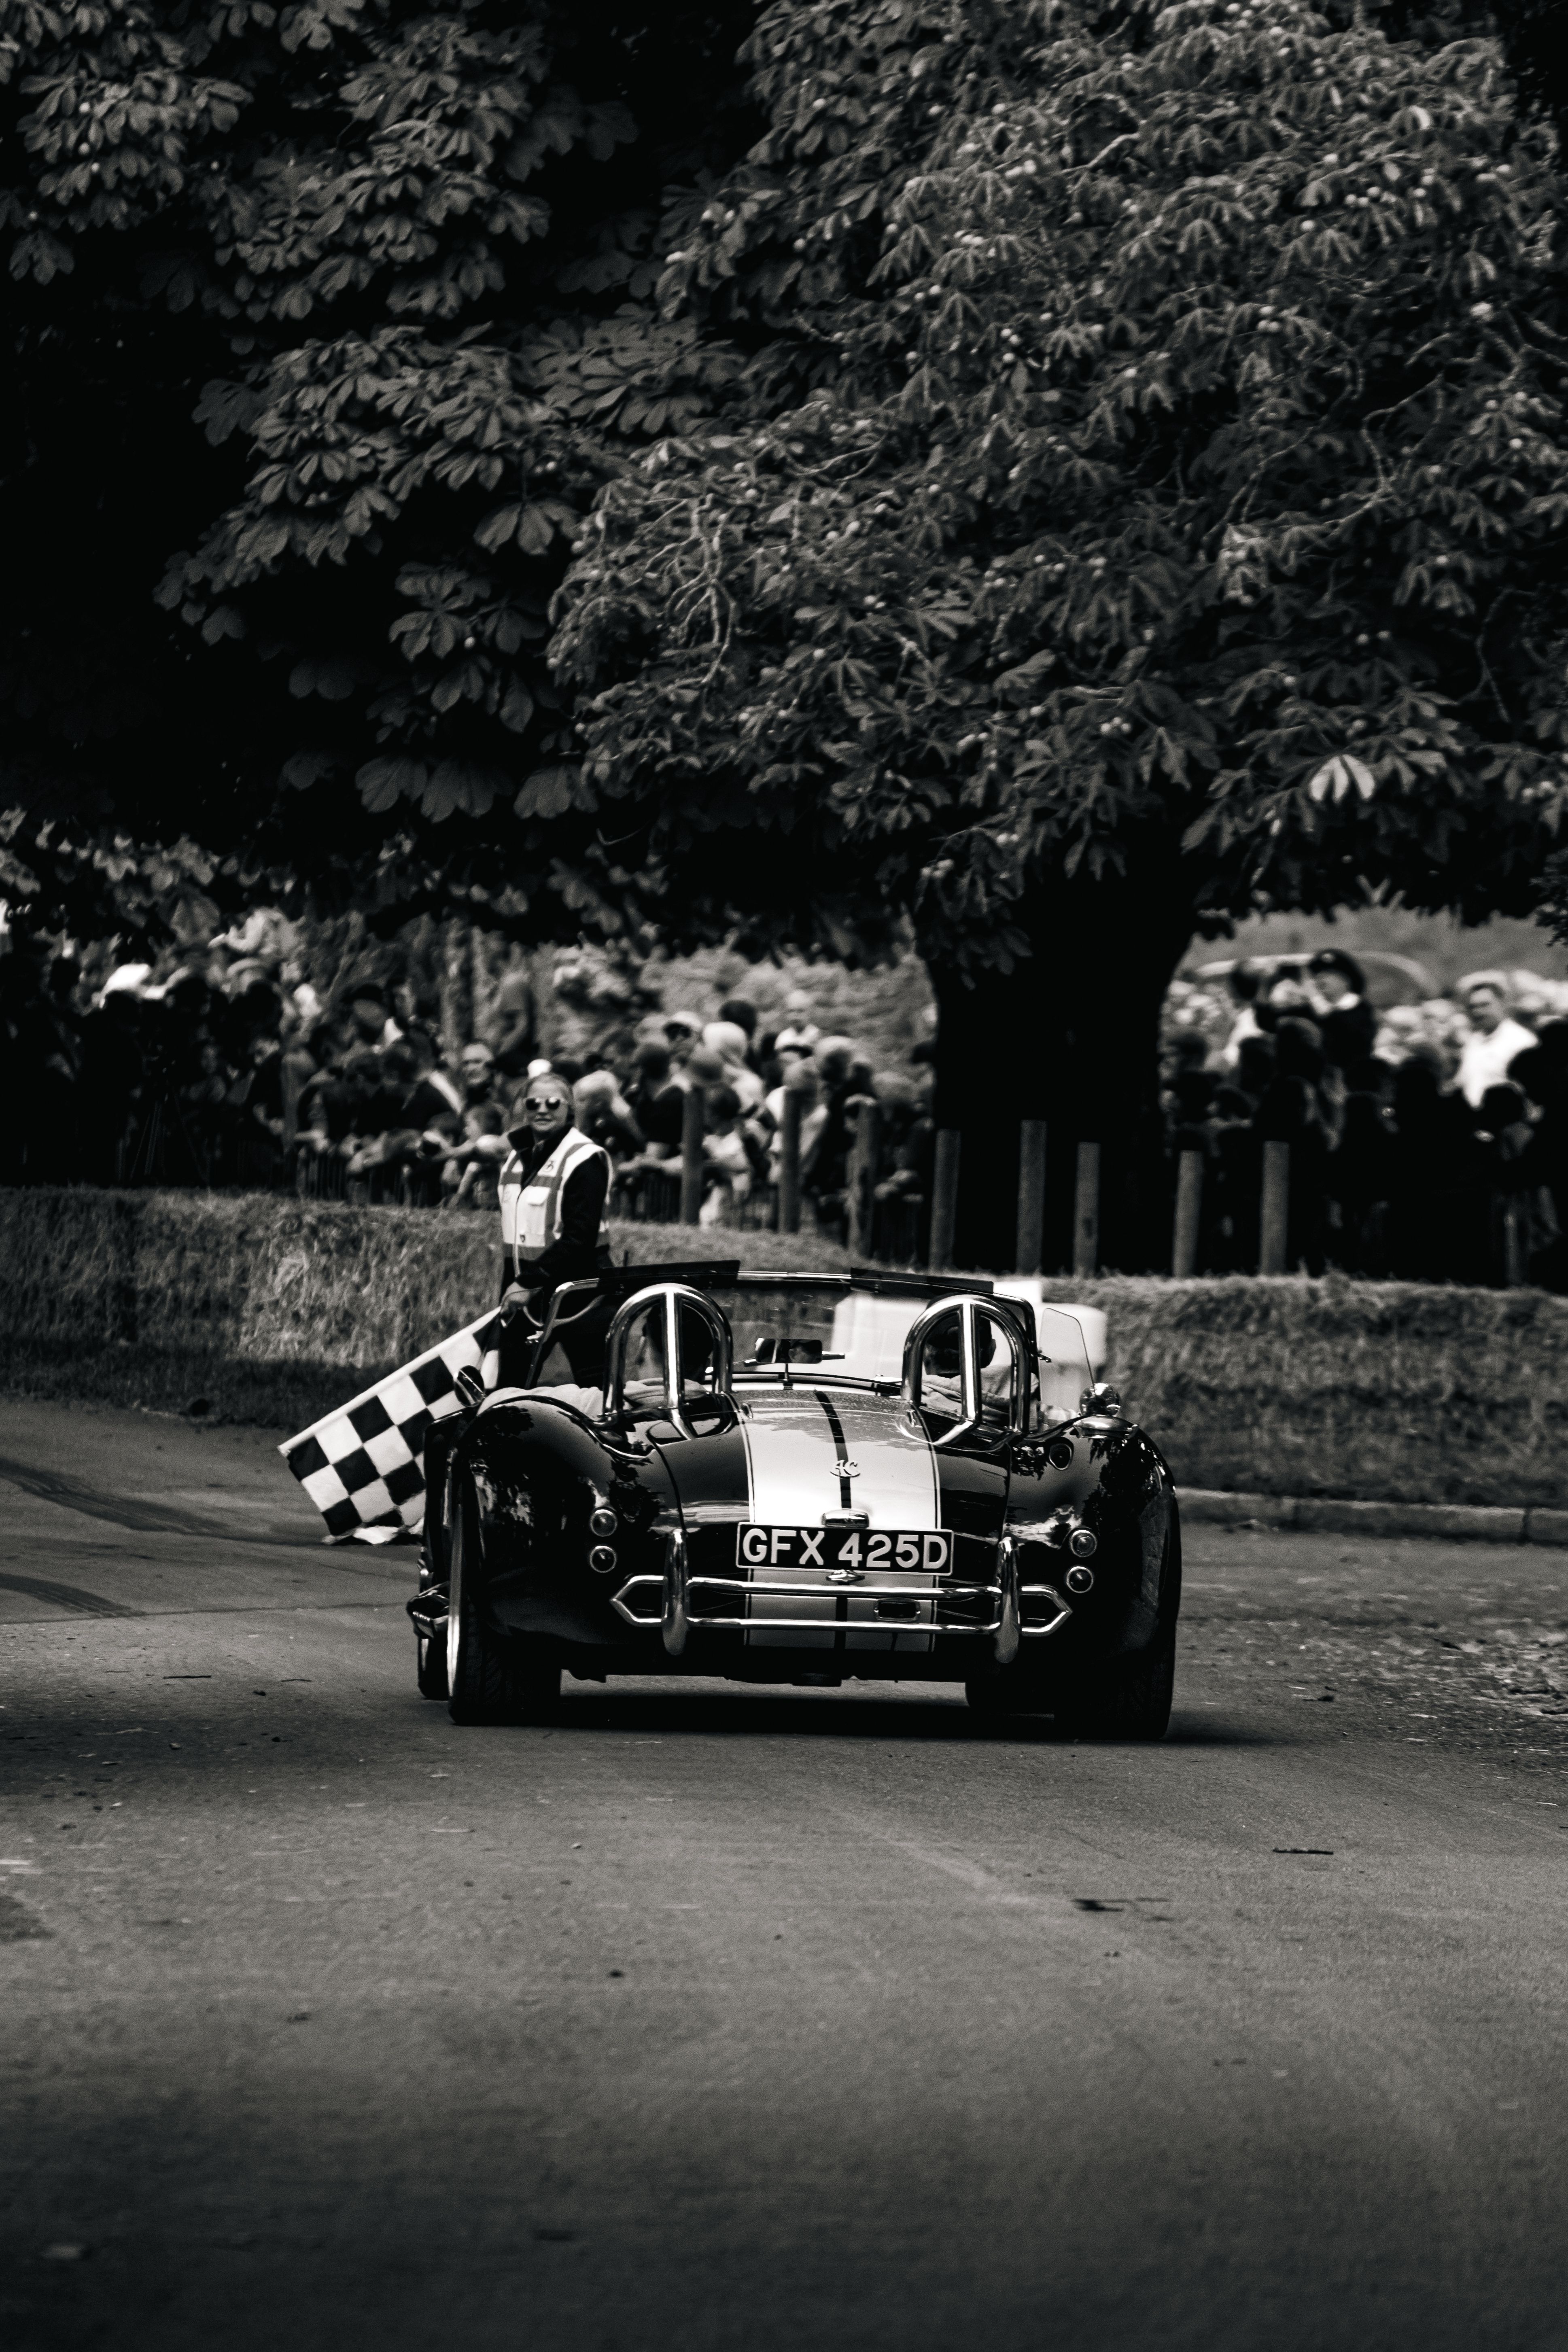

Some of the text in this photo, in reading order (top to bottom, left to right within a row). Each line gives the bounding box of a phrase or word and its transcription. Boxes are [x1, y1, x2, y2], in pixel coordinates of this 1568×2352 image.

[830, 1459, 860, 1478] AC
[743, 1528, 948, 1569] GFX 425D
